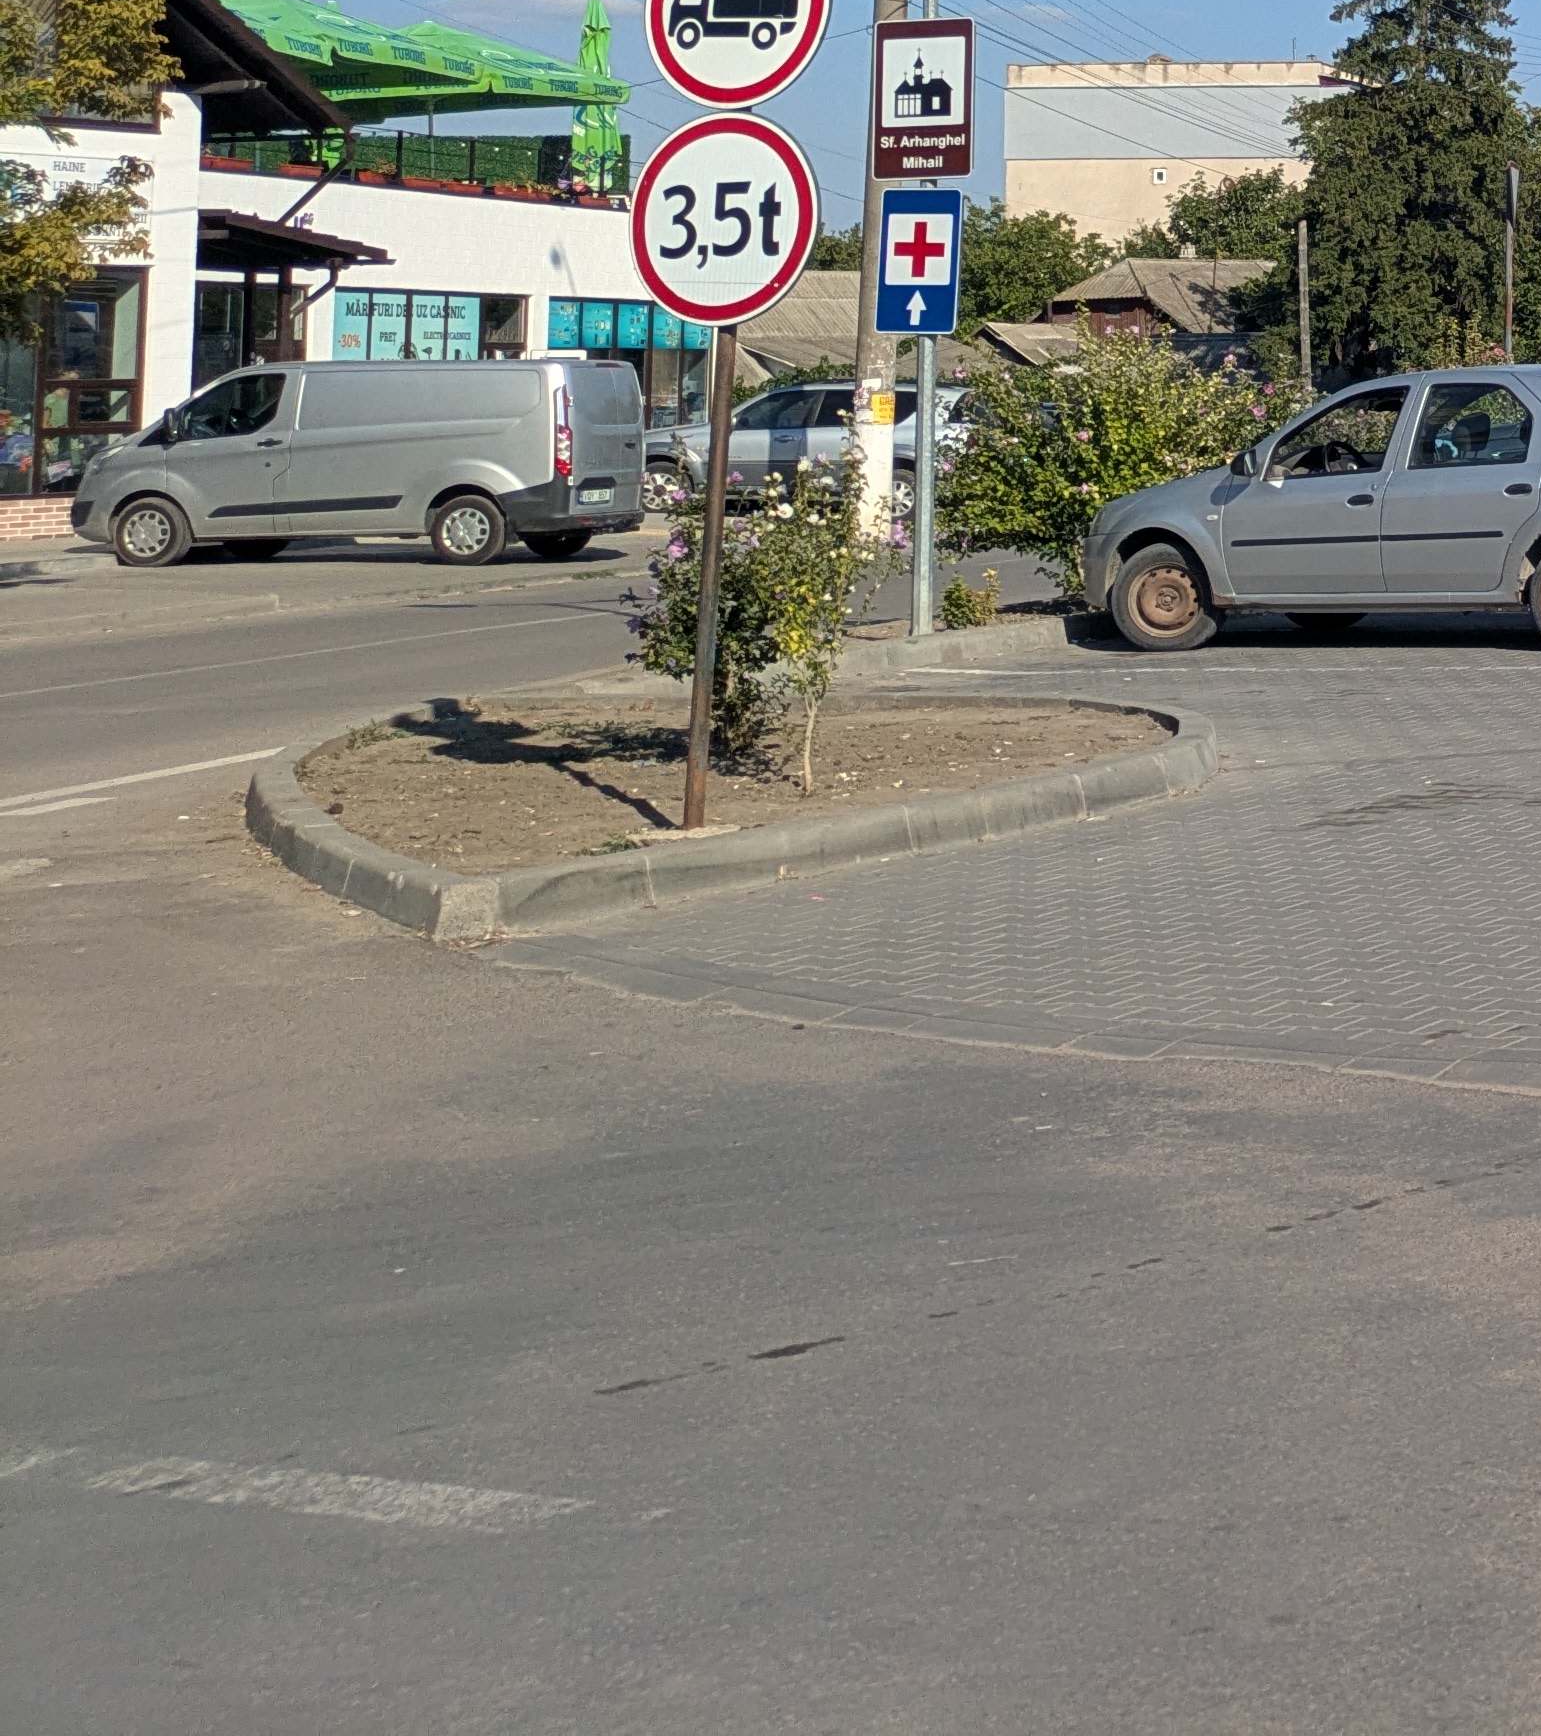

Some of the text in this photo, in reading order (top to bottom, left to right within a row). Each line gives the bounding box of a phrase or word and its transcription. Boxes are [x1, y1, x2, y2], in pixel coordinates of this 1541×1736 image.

[284, 35, 322, 56] TUBORG
[337, 37, 373, 56] TUBORG
[391, 45, 426, 65] TUBORG
[442, 56, 475, 76] TUBORG
[502, 75, 533, 90] TUBORG
[549, 79, 578, 93] TUBORG
[593, 82, 622, 97] TUBORG
[880, 133, 965, 149] Sf. Arhanghel
[53, 161, 86, 173] HAINE
[902, 156, 943, 169] Mihail
[53, 181, 101, 193] LENERI
[660, 181, 781, 269] 3,5t
[416, 304, 428, 318] UZ
